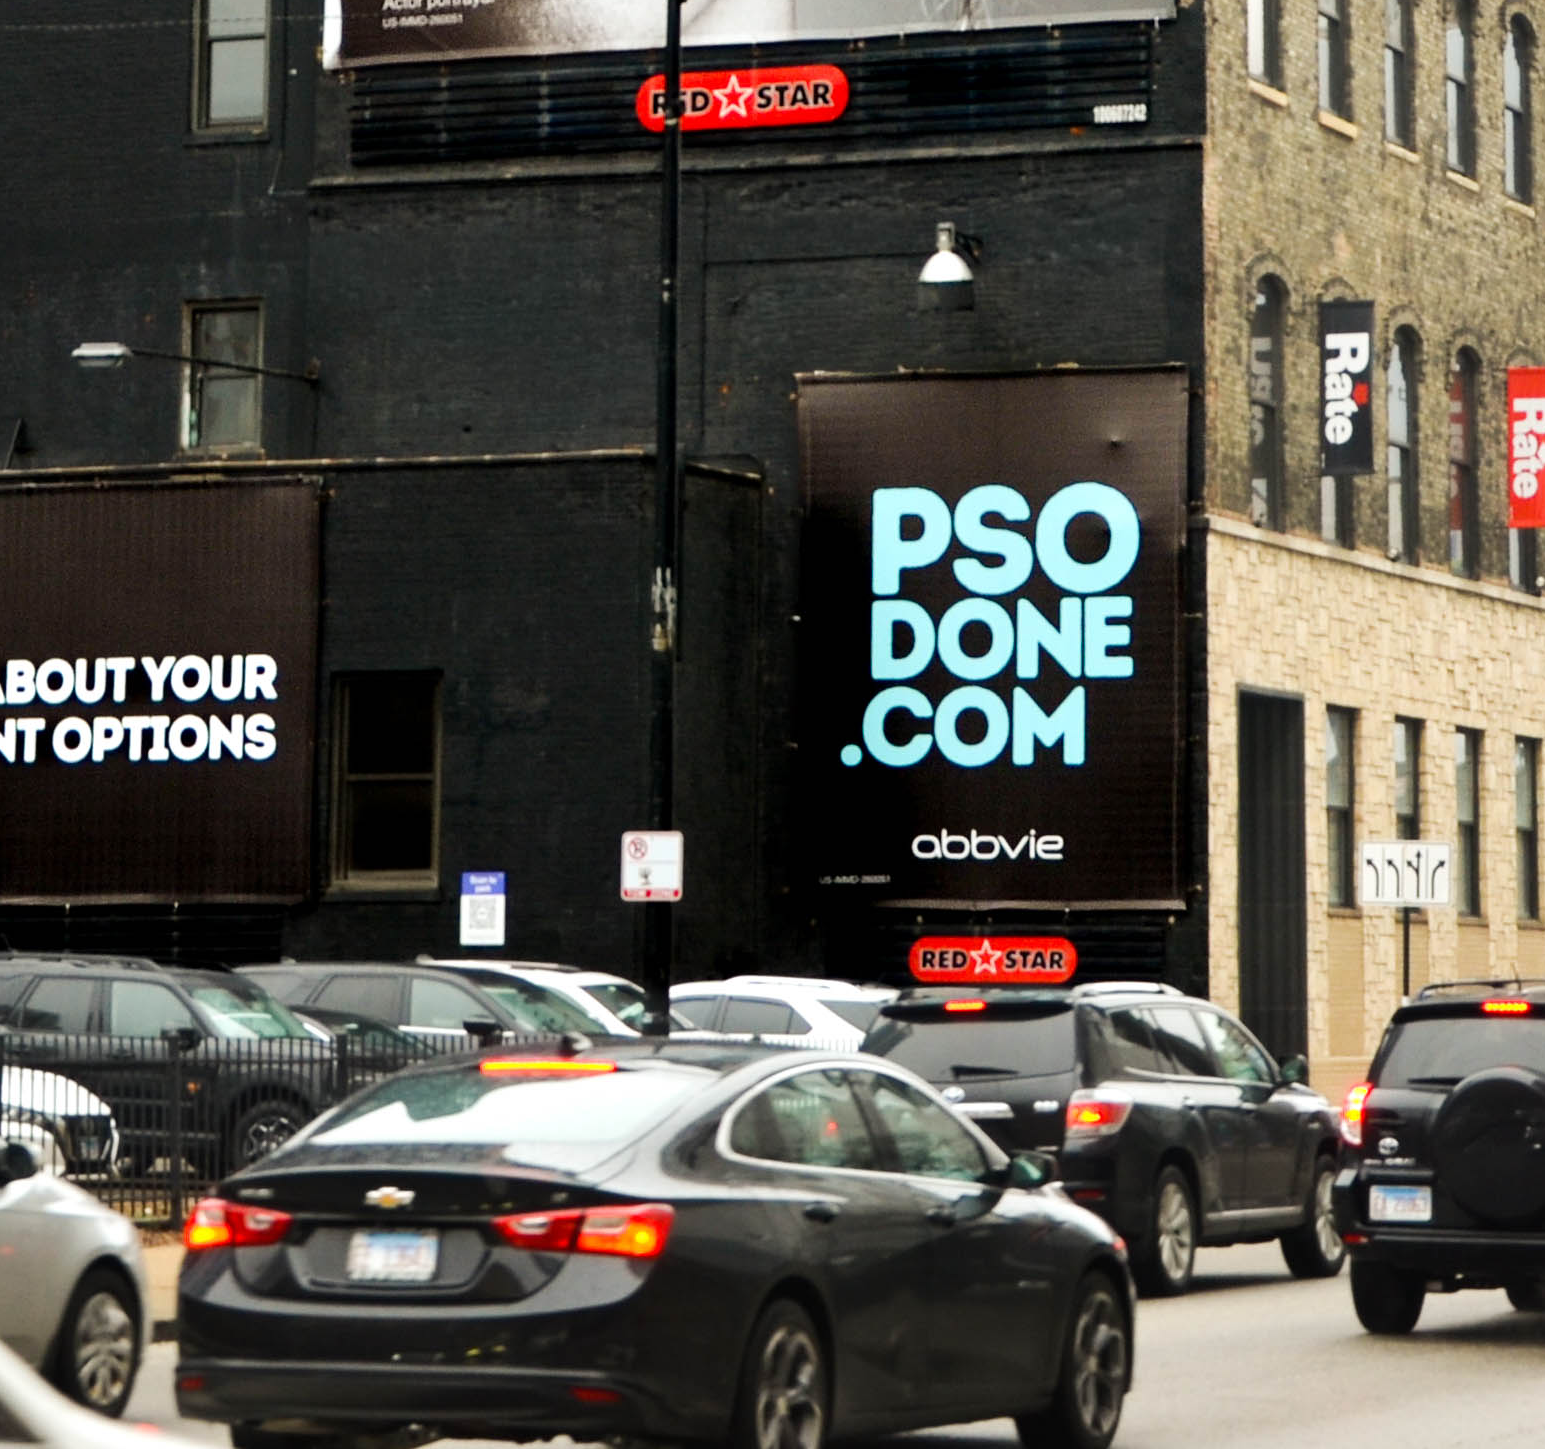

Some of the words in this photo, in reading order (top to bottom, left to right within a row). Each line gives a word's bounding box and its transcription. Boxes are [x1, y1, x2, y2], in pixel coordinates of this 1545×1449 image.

[653, 89, 711, 116] RD
[757, 83, 830, 109] STAR
[1324, 332, 1370, 445] Rate
[872, 481, 1140, 596] PSO
[871, 596, 1134, 681] DONE
[140, 653, 278, 702] YOUR
[52, 712, 278, 764] OPTIONS
[840, 685, 1086, 767] .COM
[911, 828, 1064, 861] abbvie
[921, 951, 967, 969] RED
[1004, 950, 1064, 969] STAR
